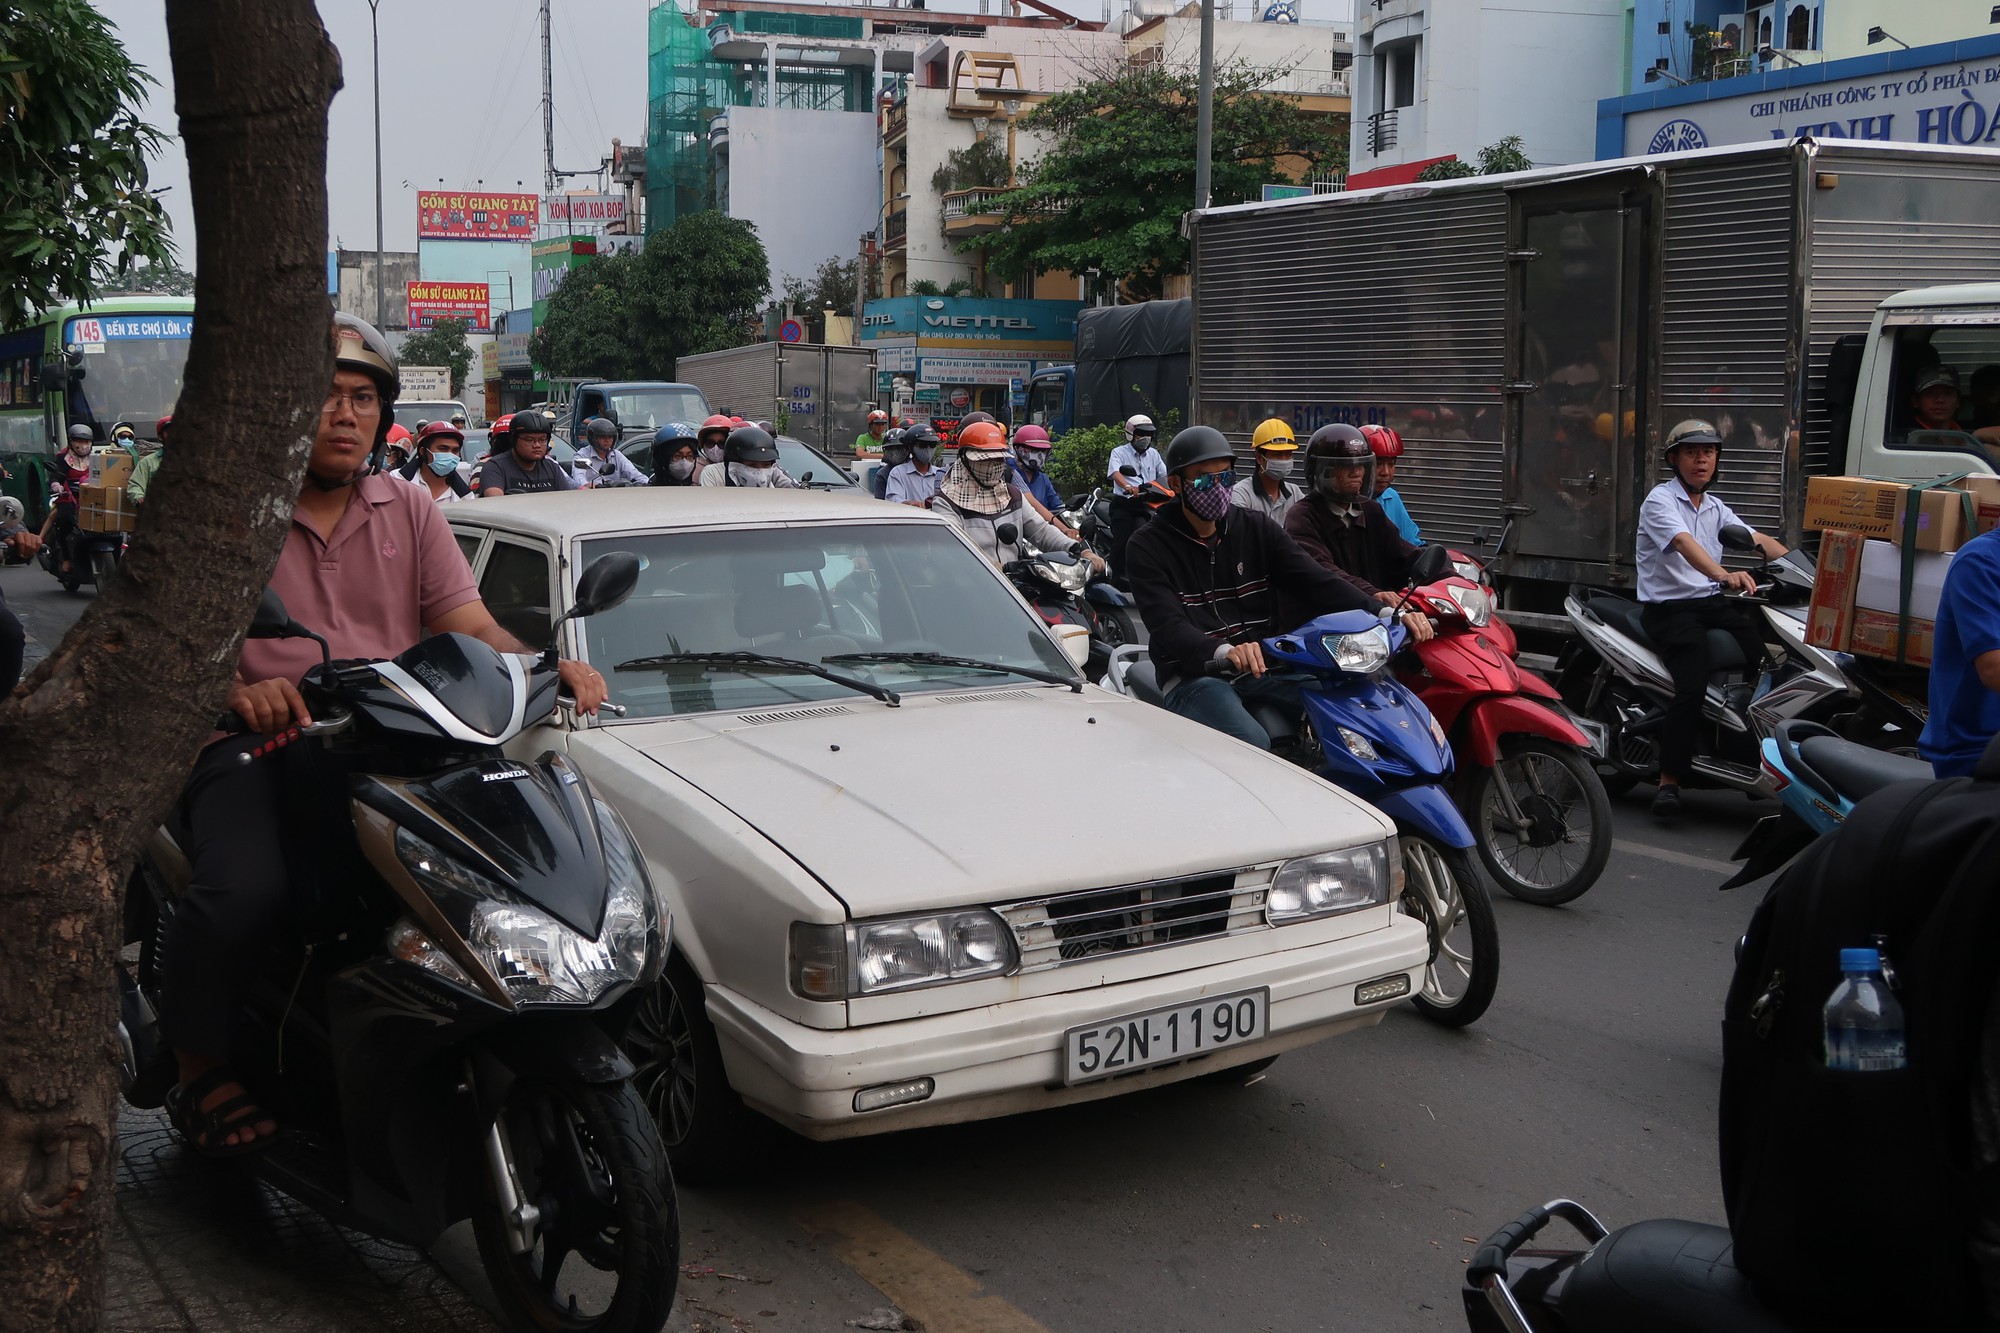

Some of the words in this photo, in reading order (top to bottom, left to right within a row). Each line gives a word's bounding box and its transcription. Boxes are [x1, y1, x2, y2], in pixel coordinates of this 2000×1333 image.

[1750, 102, 1774, 118] CHI
[1779, 92, 1832, 114] NHÁNH
[1836, 87, 1876, 104] CÔNG
[1881, 82, 1903, 99] TY
[1906, 71, 1928, 94] CỔ
[1932, 65, 1980, 92] PHẦN
[1770, 114, 1895, 141] NH
[420, 193, 447, 209] GỐM
[450, 194, 466, 209] SỨ
[470, 198, 508, 210] GIANG
[512, 196, 536, 211] TÂY
[550, 199, 570, 219] XÔNG
[590, 202, 604, 219] XOA
[607, 198, 623, 218] BÓP
[411, 283, 428, 299] GỐM
[430, 285, 441, 300] SỨ
[442, 288, 468, 300] GIANG
[470, 286, 486, 300] TÂY
[76, 322, 100, 342] 145
[106, 320, 125, 336] BẾN
[128, 323, 140, 336] XE
[141, 323, 161, 338] CHỢ
[162, 320, 181, 334] LỚN
[922, 314, 1036, 329] VIETTEL
[793, 387, 810, 398] 51D
[482, 770, 530, 782] HONDA
[1079, 998, 1255, 1073] 52N-1190
